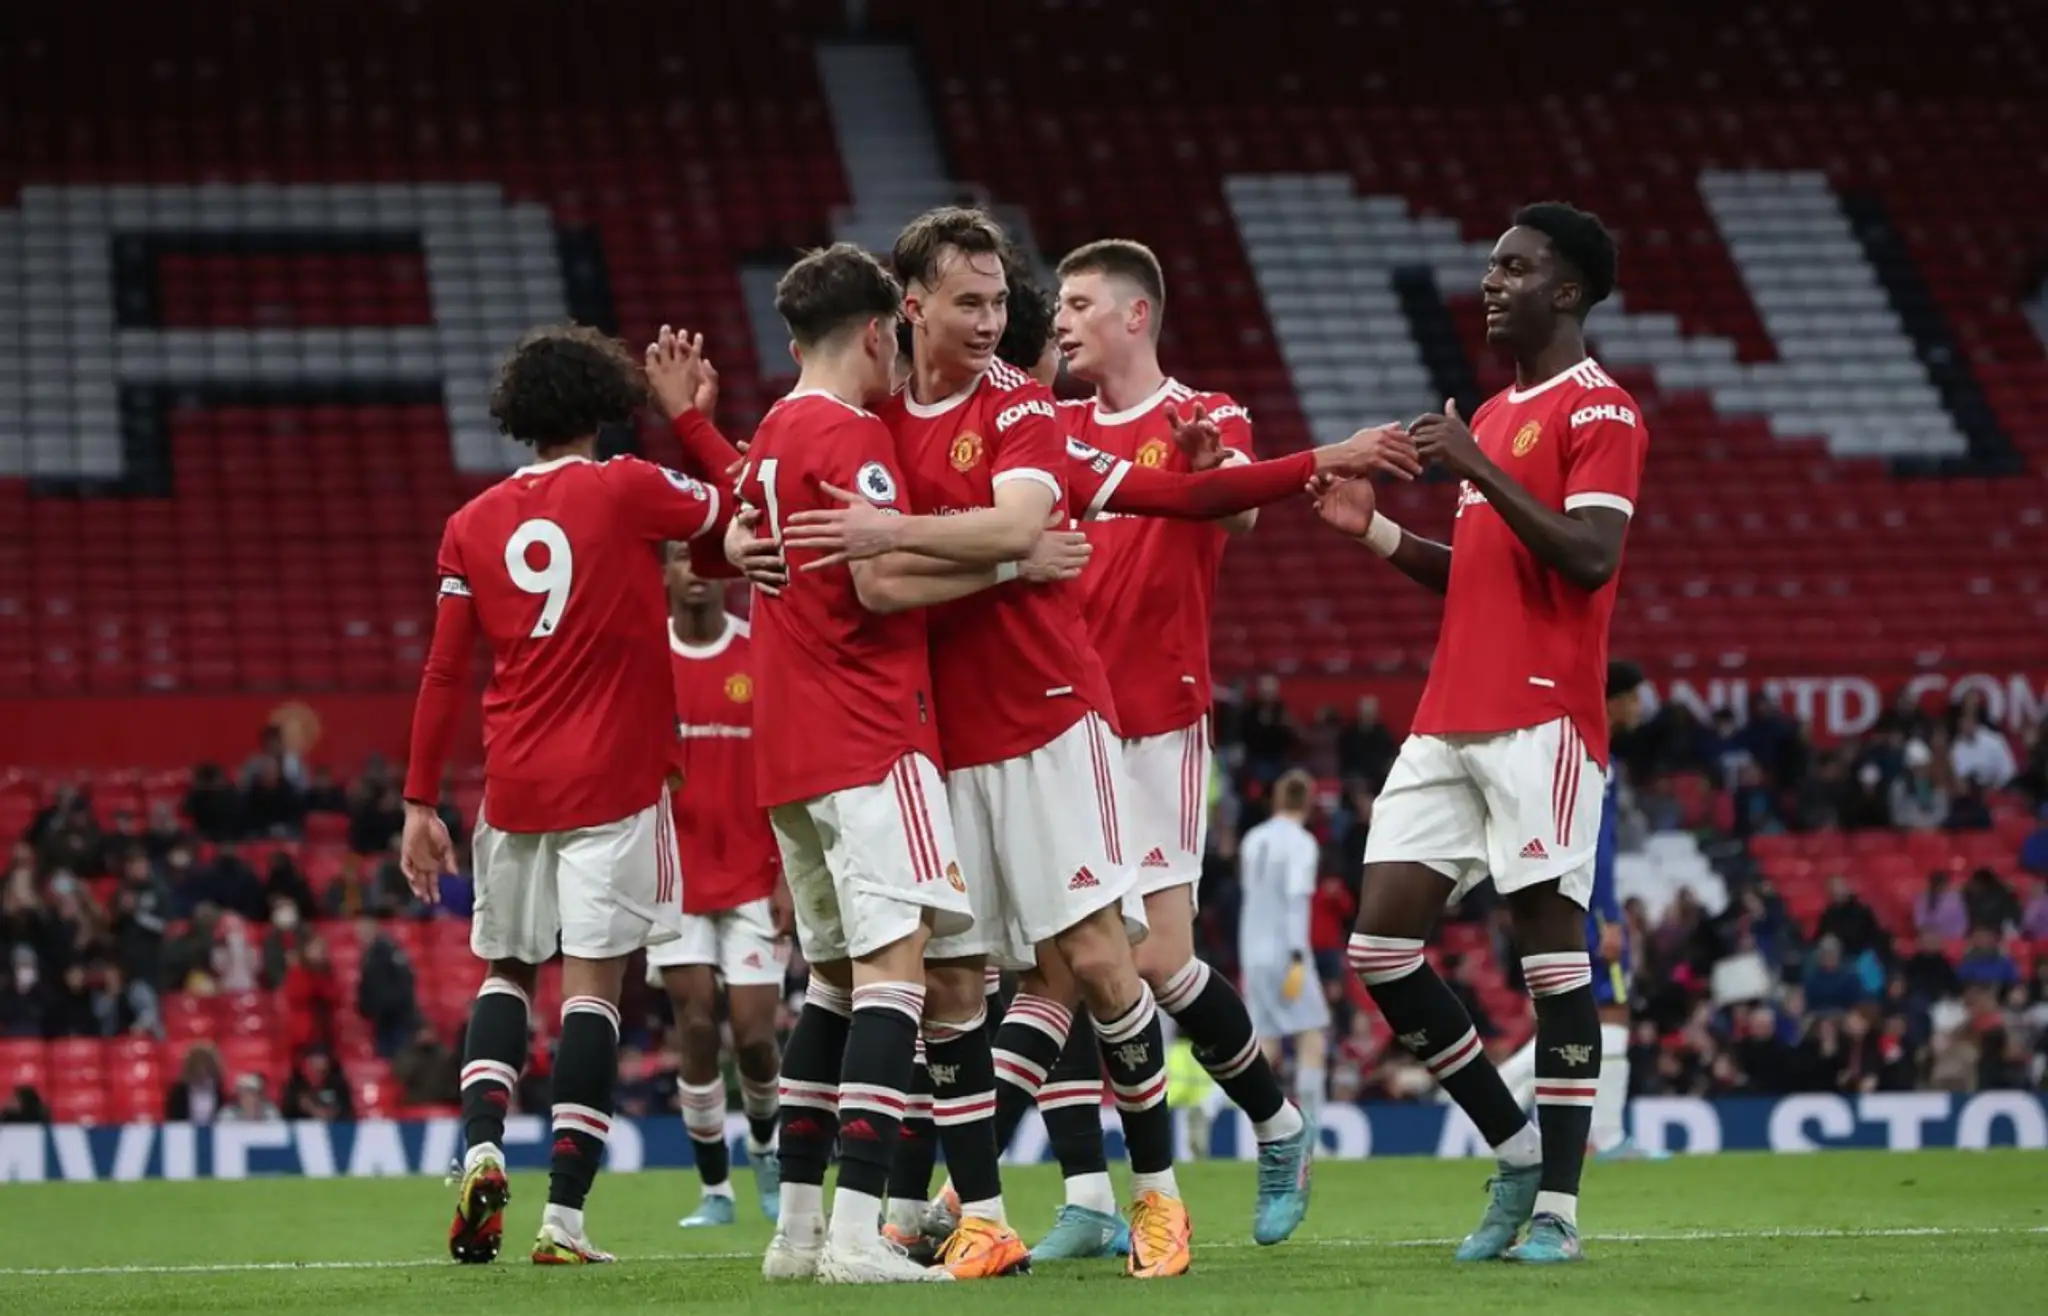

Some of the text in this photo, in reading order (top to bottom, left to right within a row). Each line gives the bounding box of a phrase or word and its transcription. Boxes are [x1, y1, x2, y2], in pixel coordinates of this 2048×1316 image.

[995, 399, 1056, 433] KOHLE
[1570, 403, 1637, 429] KOHLER
[504, 517, 574, 639] 9
